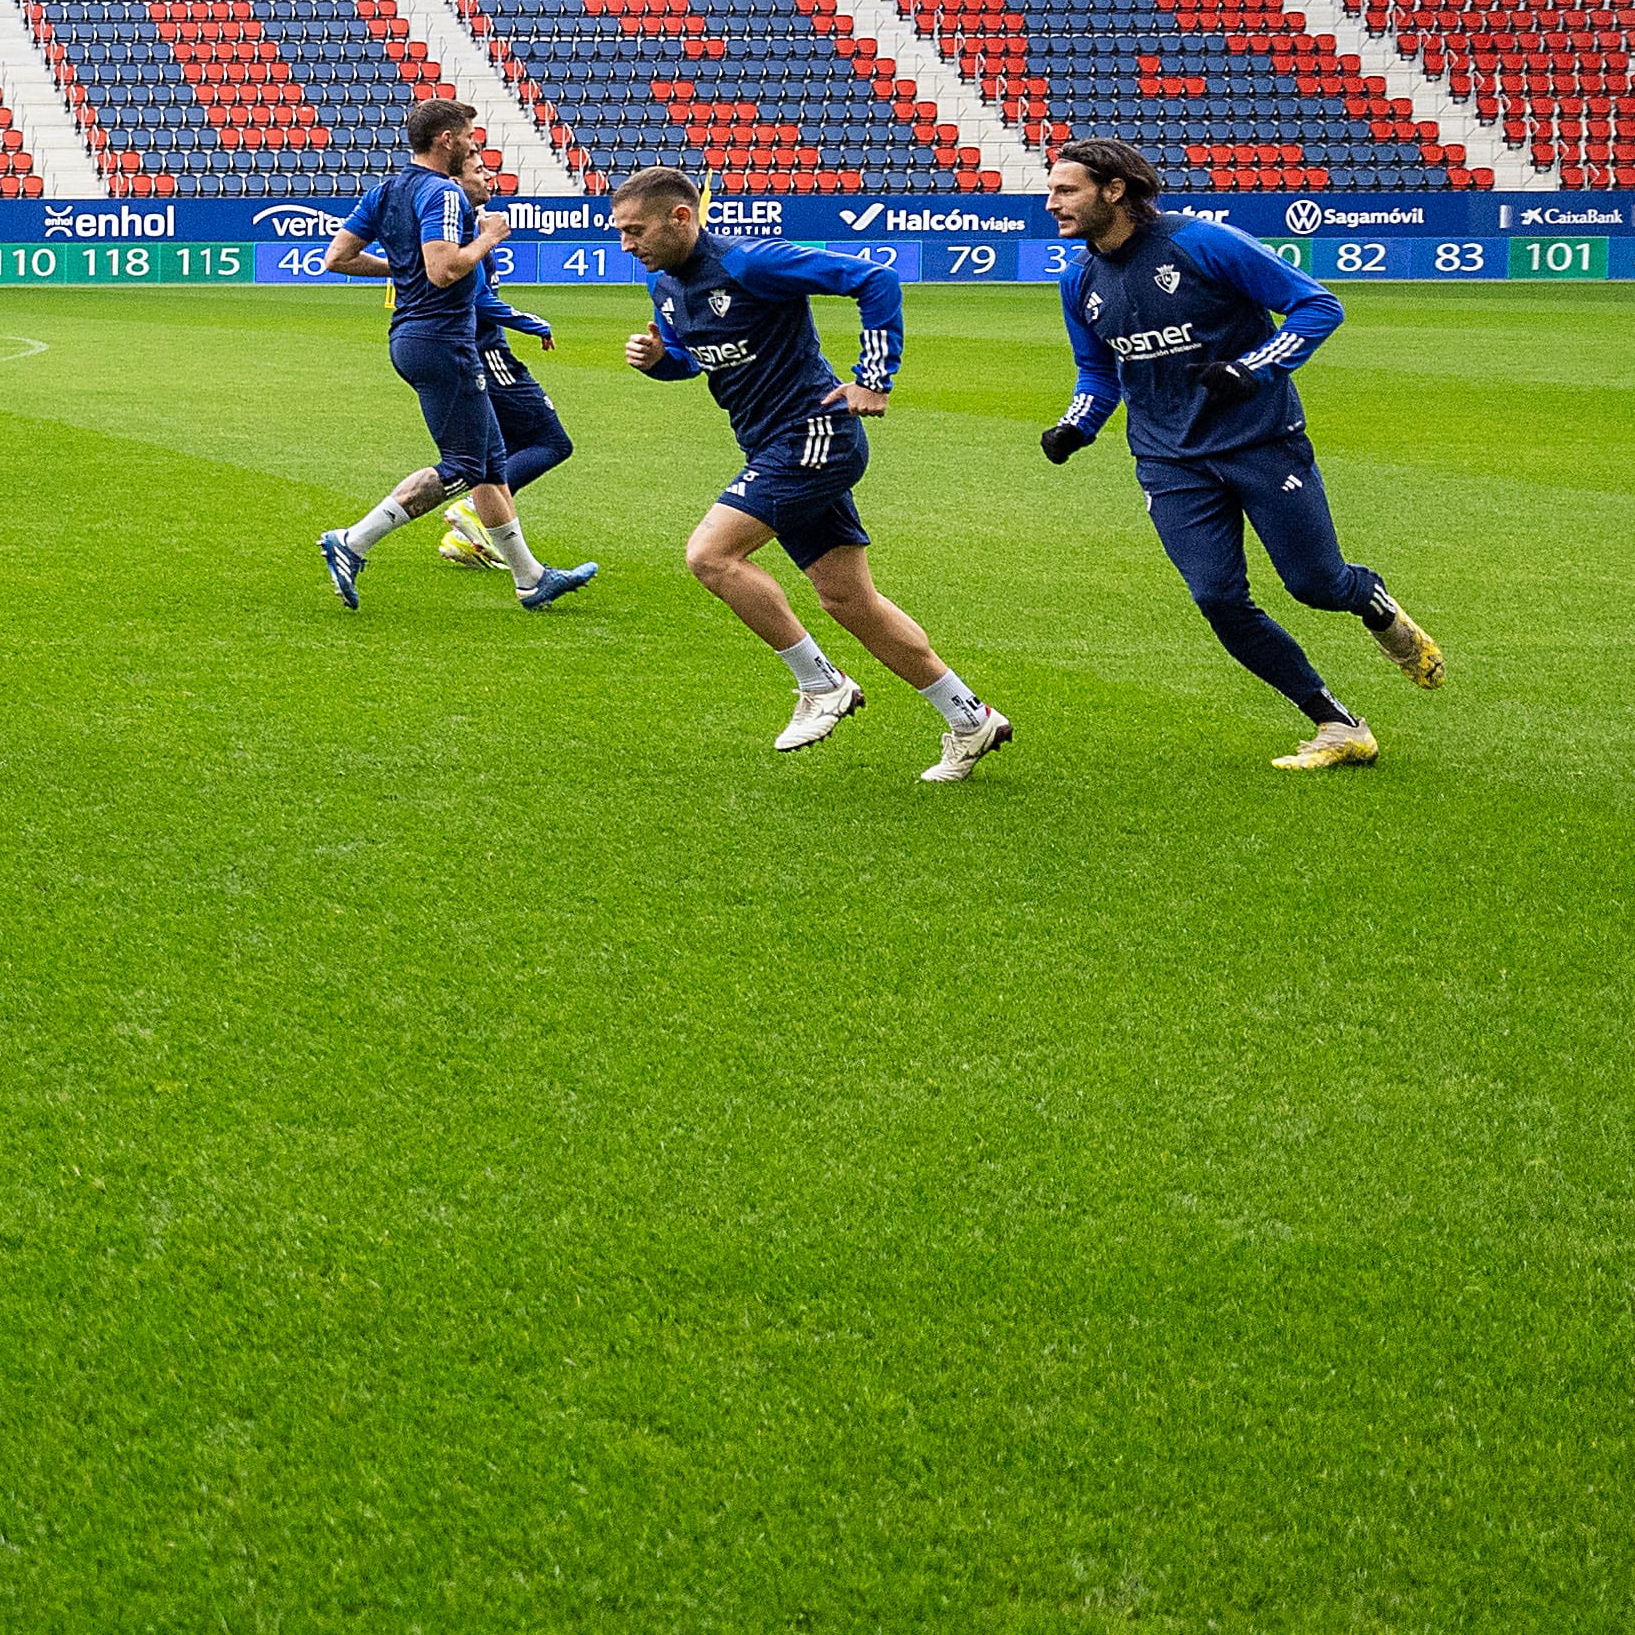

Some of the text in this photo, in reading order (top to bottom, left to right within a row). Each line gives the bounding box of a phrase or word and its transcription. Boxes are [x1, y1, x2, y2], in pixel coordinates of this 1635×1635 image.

[75, 204, 176, 238] enhol
[507, 202, 590, 235] Miguel
[887, 209, 1026, 232] Halcón viajes
[1323, 207, 1425, 228] Sagamóvil
[1544, 207, 1624, 225] CaixaBank
[82, 248, 150, 276] 118
[176, 247, 241, 276] 115
[278, 248, 326, 276] 46
[563, 247, 607, 276] 41
[946, 244, 996, 275] 79
[1336, 243, 1387, 273] 82
[1434, 243, 1485, 272] 83
[1526, 243, 1591, 272] 101
